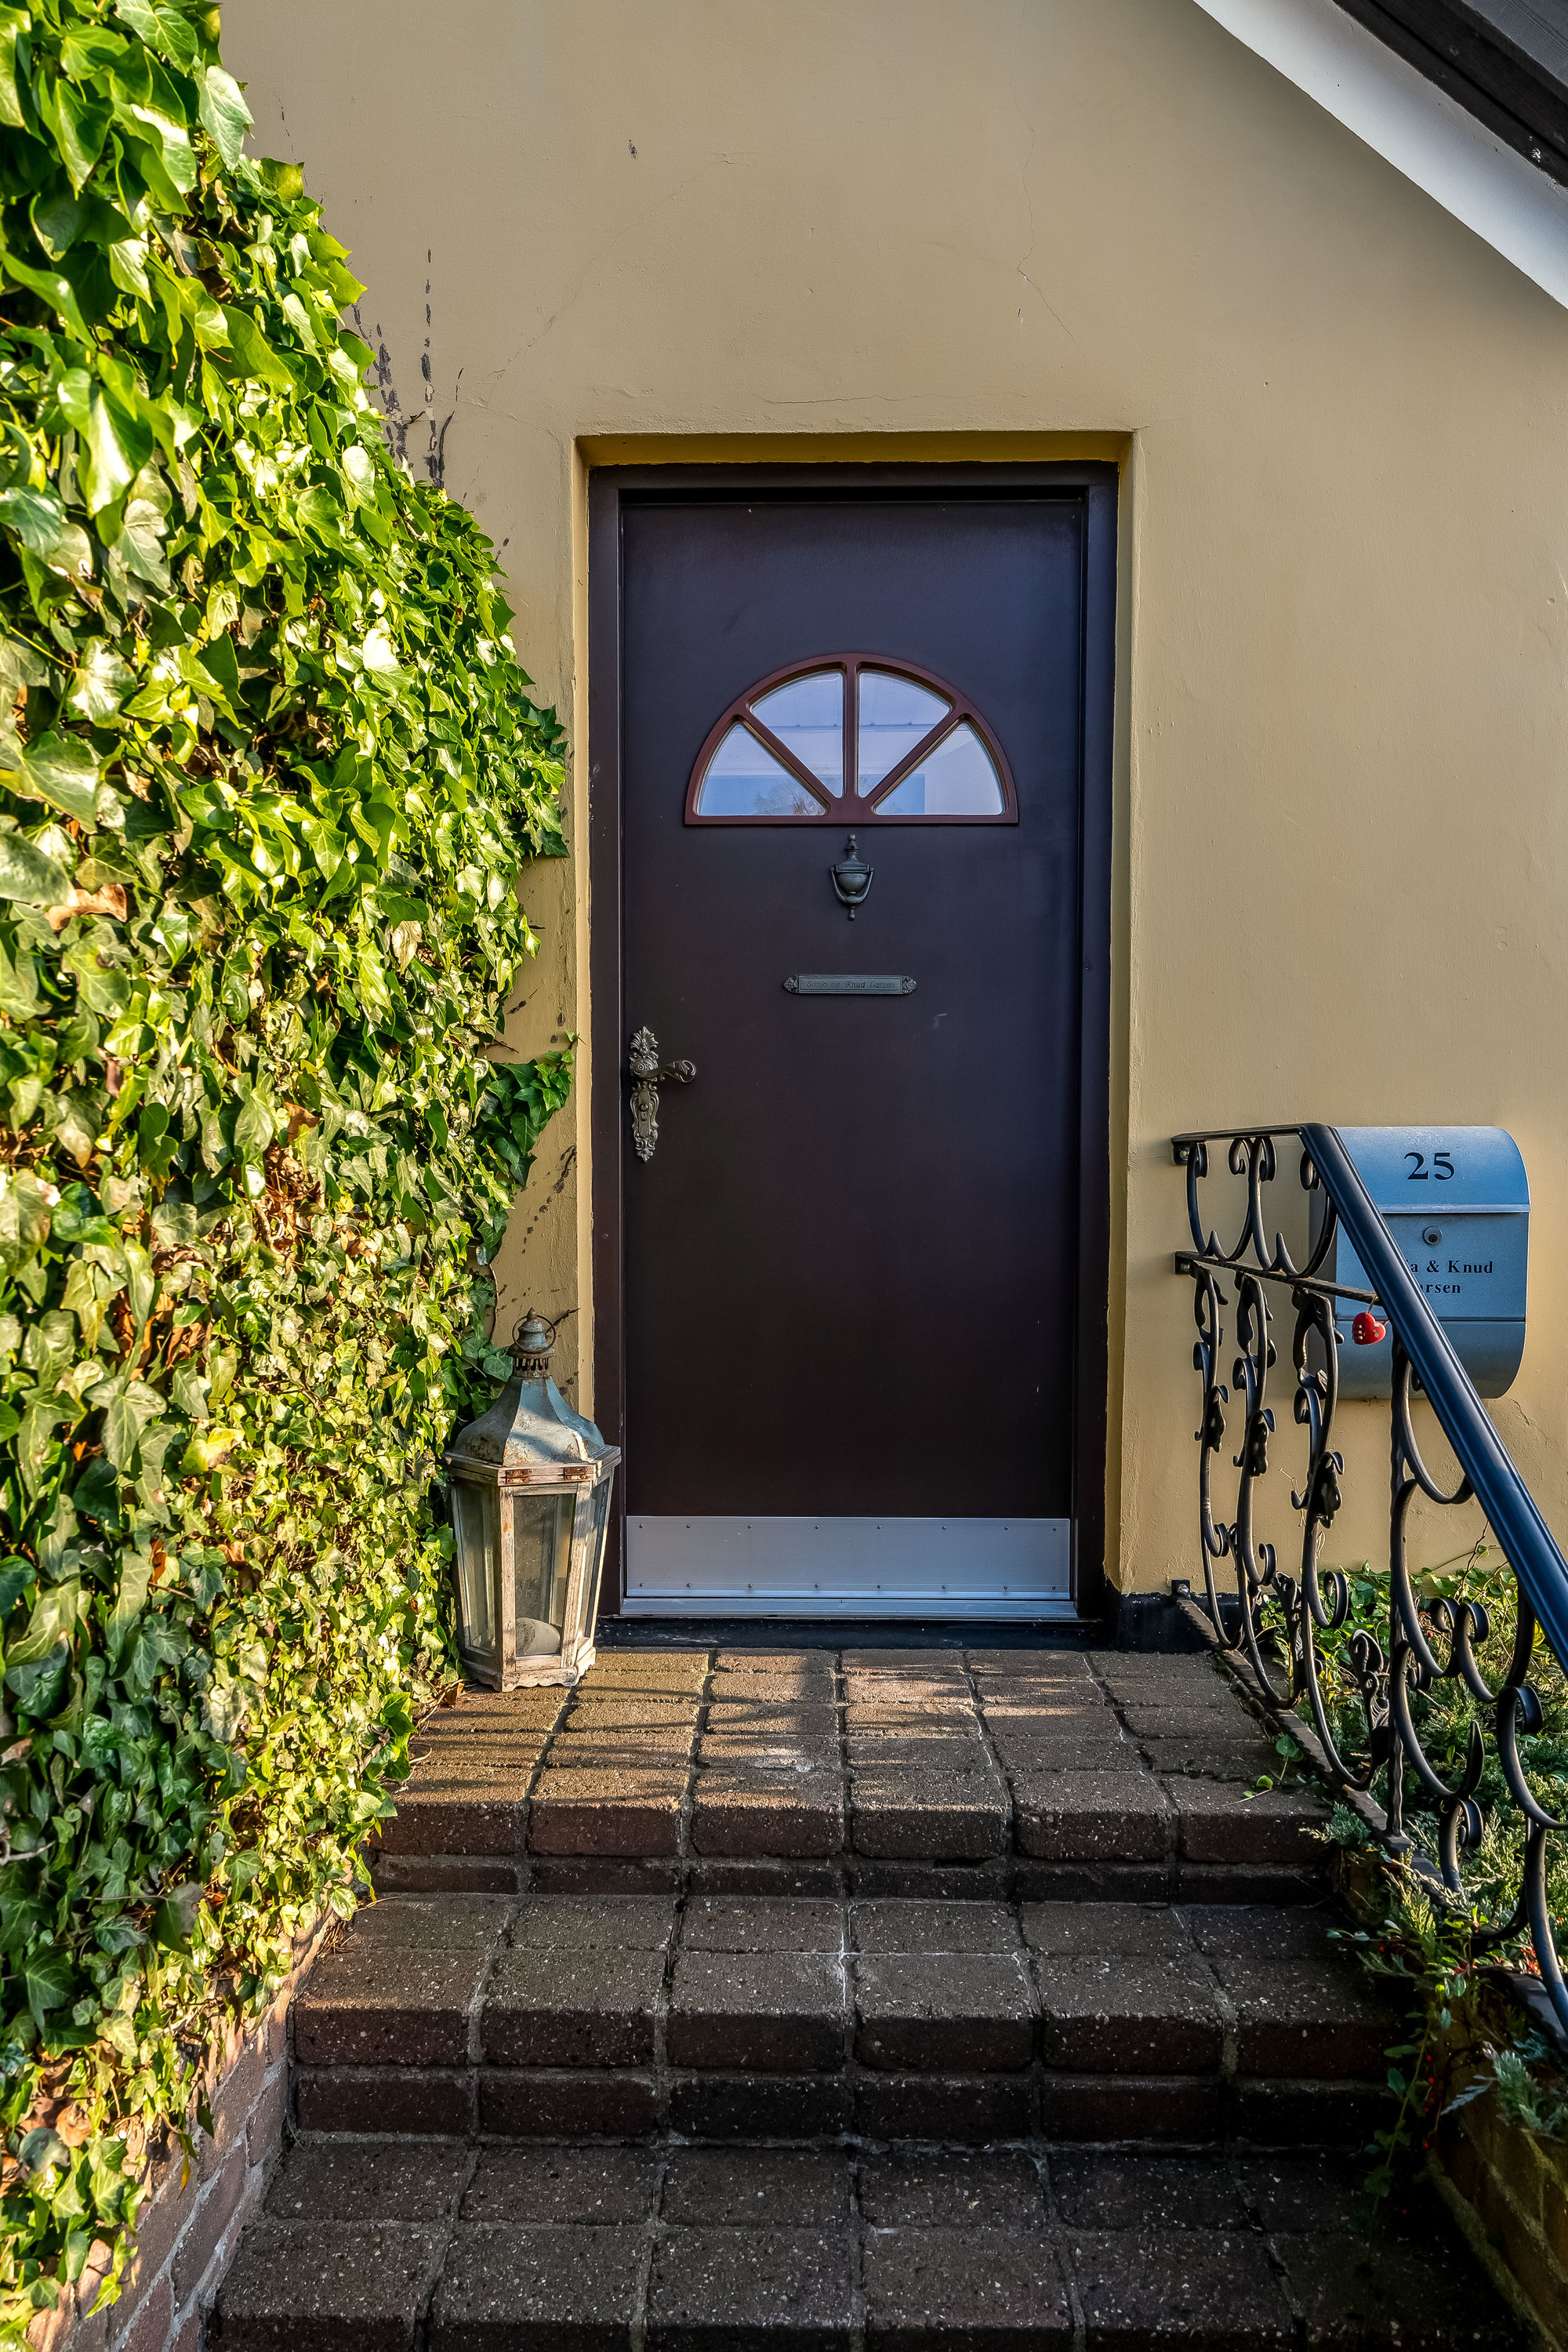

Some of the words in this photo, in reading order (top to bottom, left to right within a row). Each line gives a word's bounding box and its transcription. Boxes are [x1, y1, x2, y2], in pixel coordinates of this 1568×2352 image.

[844, 980, 866, 989] Knud
[1404, 1152, 1455, 1180] 25
[1427, 1259, 1440, 1273] &
[1447, 1260, 1493, 1274] Knud
